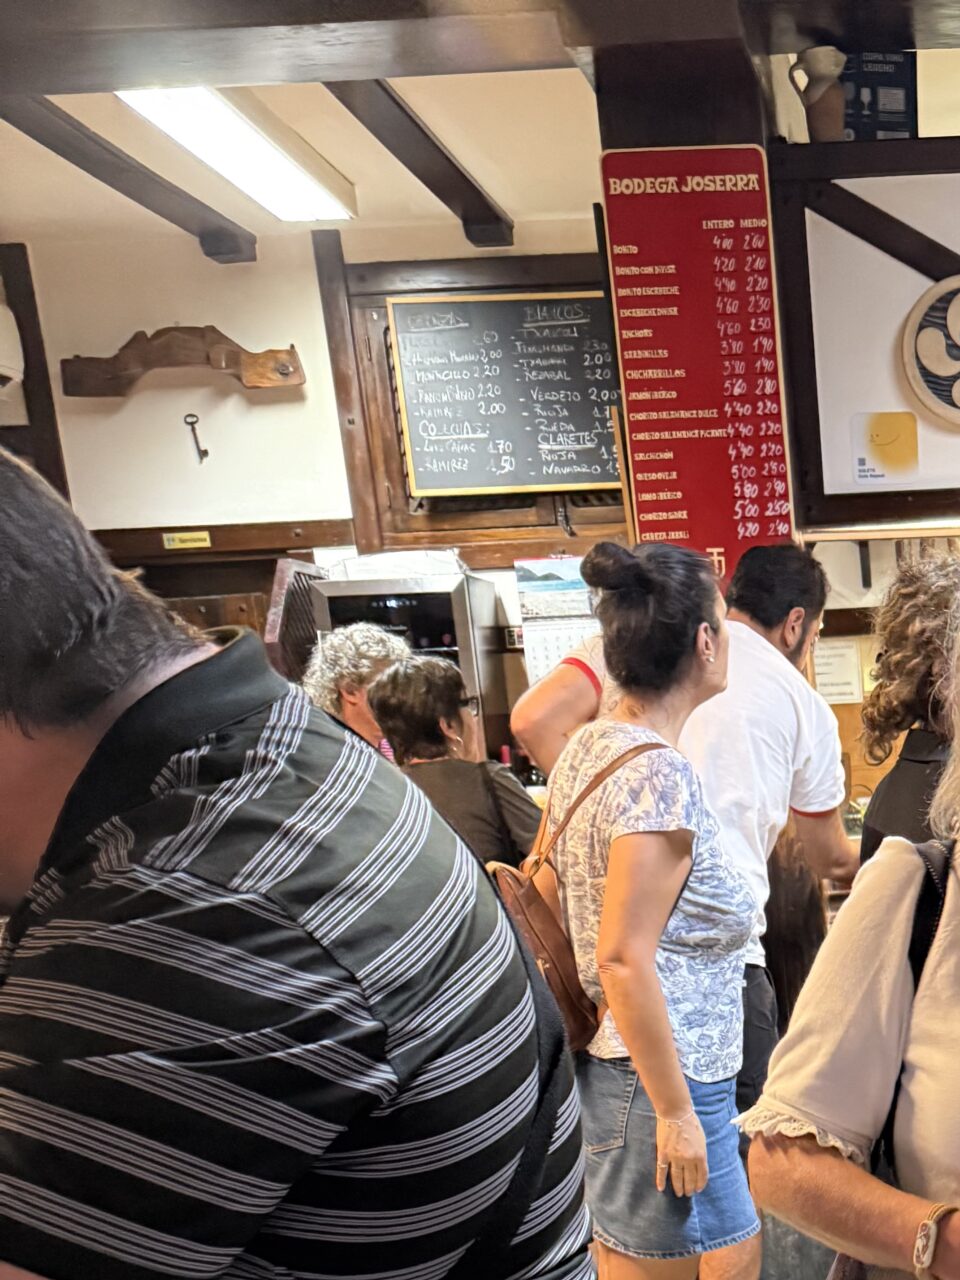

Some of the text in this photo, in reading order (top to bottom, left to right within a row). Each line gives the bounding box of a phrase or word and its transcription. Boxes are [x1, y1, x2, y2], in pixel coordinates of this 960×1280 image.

[608, 173, 760, 195] BODEGA JOSERRA
[702, 218, 768, 230] ENTERO MEDIO
[613, 244, 638, 254] BONITO
[615, 266, 640, 276] BONITO
[617, 287, 641, 297] BONITO
[626, 369, 686, 379] CHICHARRILLOS
[629, 411, 658, 421] CHORIZO
[699, 408, 719, 418] DULCE
[632, 431, 660, 441] CHORIZO
[700, 428, 728, 438] PICANTE
[641, 531, 667, 541] CABEZA
